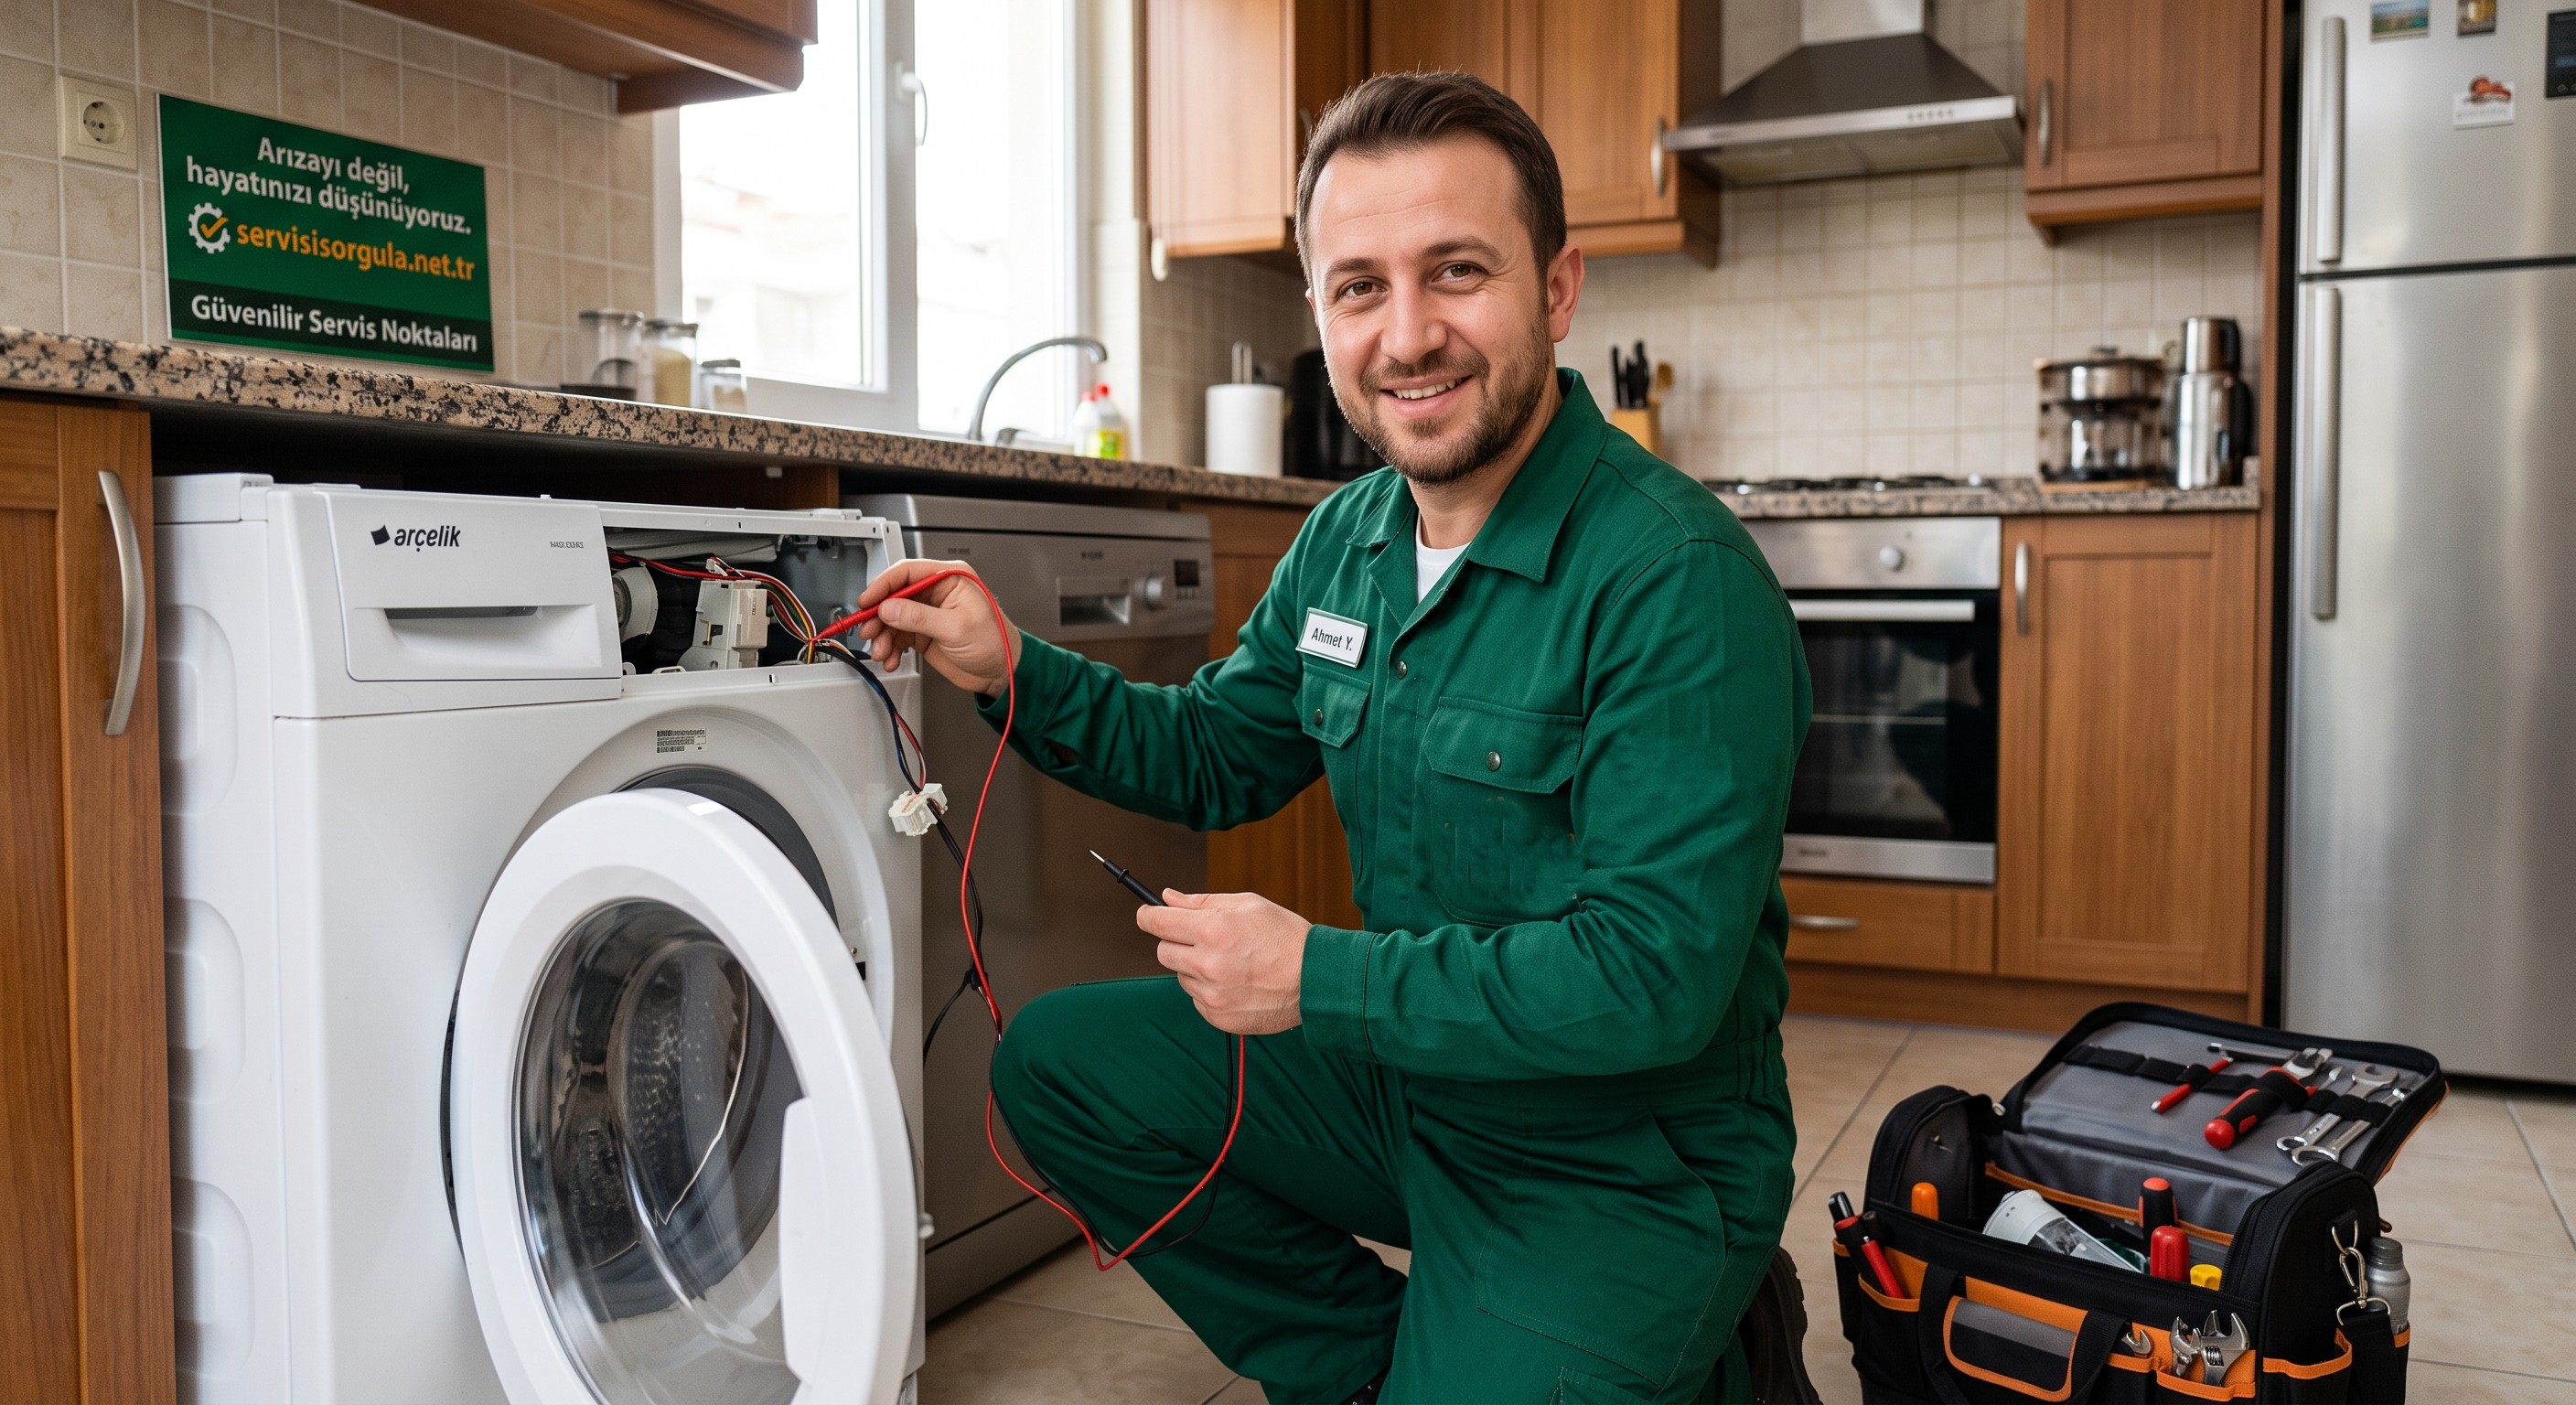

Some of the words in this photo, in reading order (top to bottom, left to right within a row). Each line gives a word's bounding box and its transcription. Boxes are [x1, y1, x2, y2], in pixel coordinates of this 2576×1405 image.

[257, 136, 341, 181] Arızayı
[347, 156, 410, 195] değil,
[187, 156, 312, 205] hayatınızı
[318, 184, 471, 235] düşünüyoruz.
[236, 222, 475, 280] servisisorgula.net.tr
[191, 294, 304, 331] Güvenilir
[309, 309, 377, 340] Servis
[382, 318, 477, 352] Noktaları
[394, 525, 461, 552] arçelik
[1311, 627, 1343, 649] Ahmet
[1346, 636, 1353, 651] Y.
